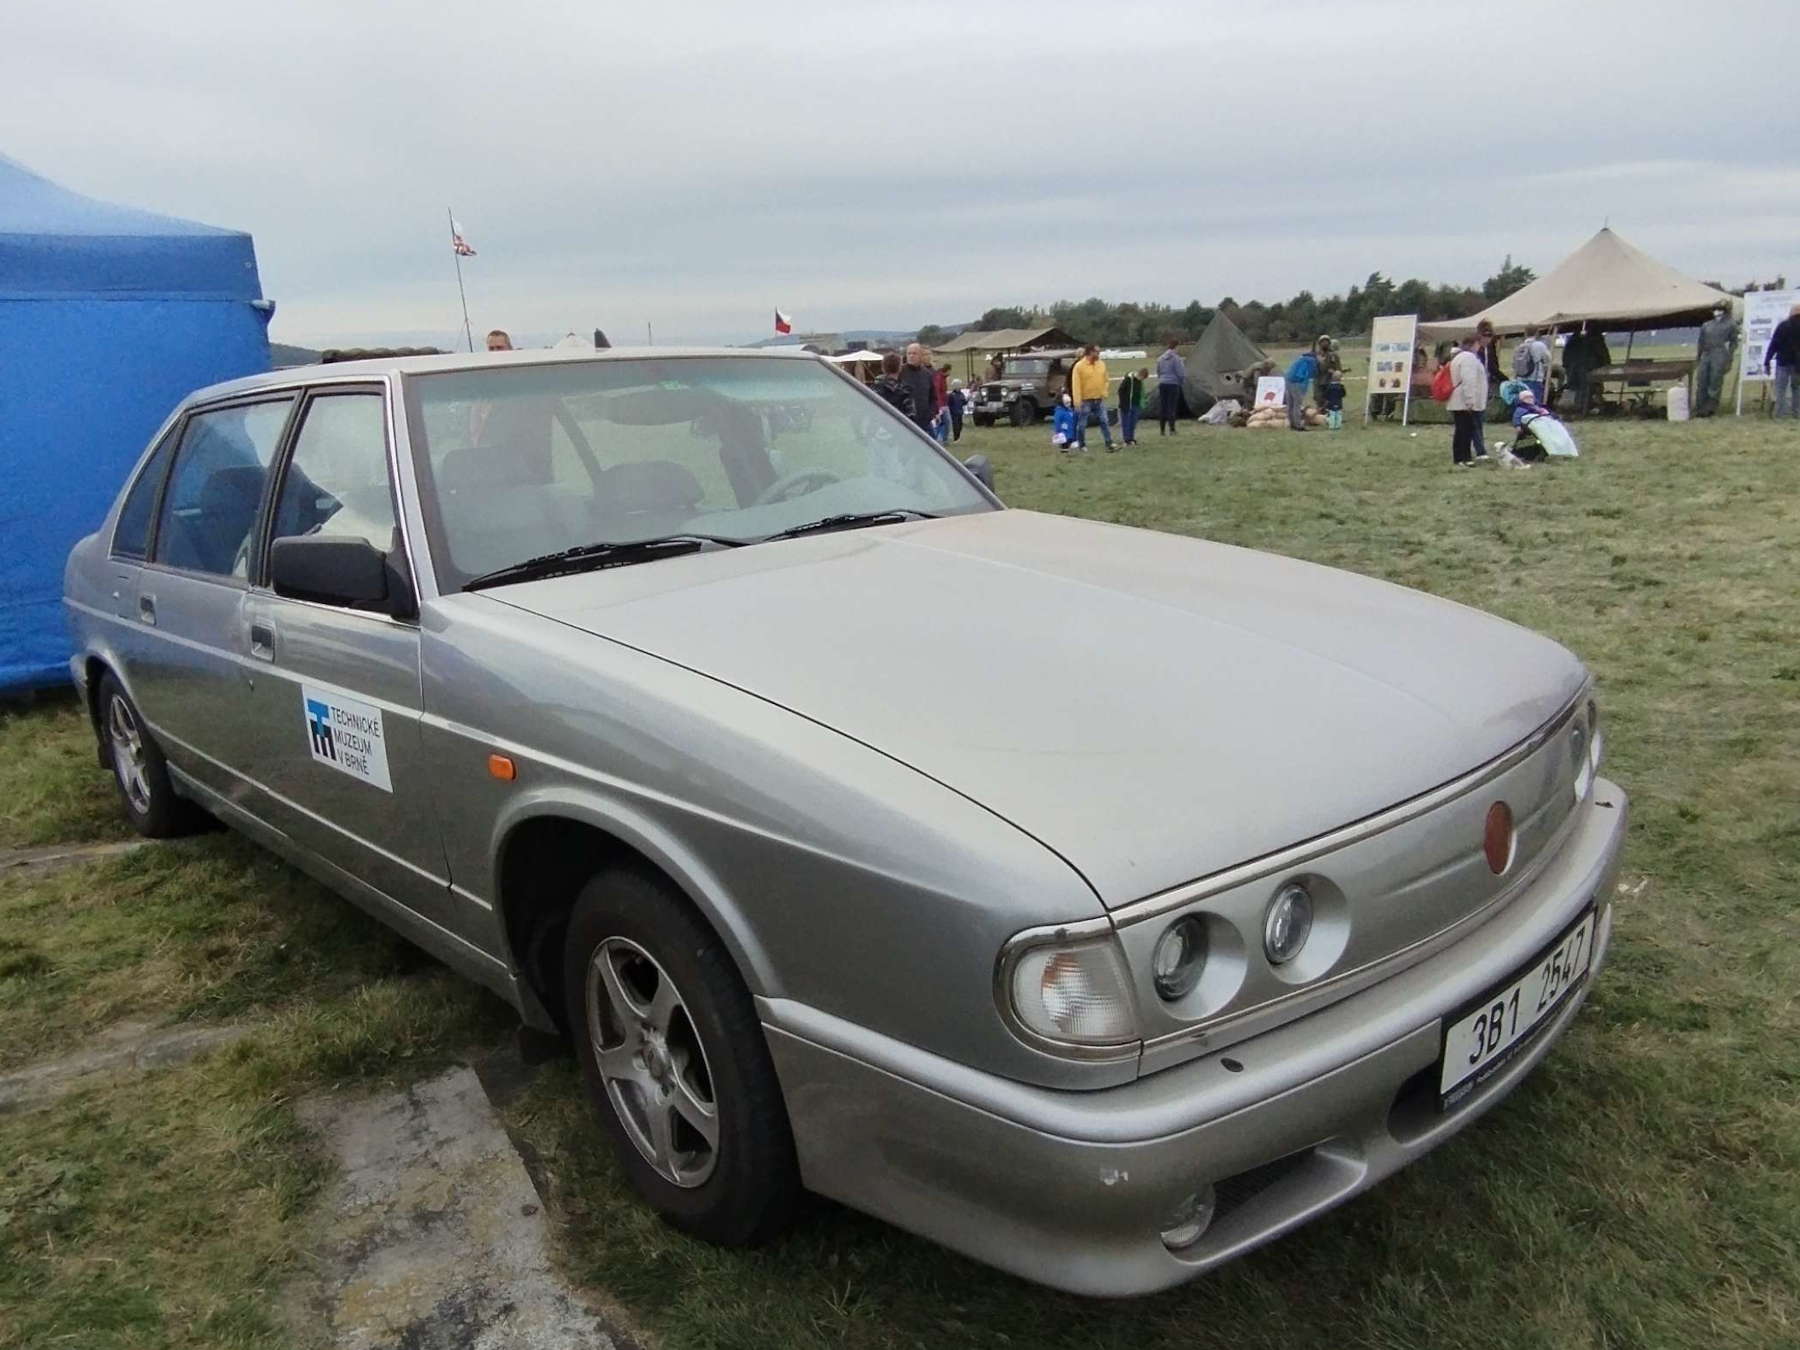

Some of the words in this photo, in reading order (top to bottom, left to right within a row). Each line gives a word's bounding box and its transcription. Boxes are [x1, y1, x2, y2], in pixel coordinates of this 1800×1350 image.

[330, 706, 381, 738] TECHNICKÉ
[334, 729, 372, 756] MUZEUM
[1469, 988, 1520, 1065] 3B1
[1537, 926, 1586, 1012] 2547
